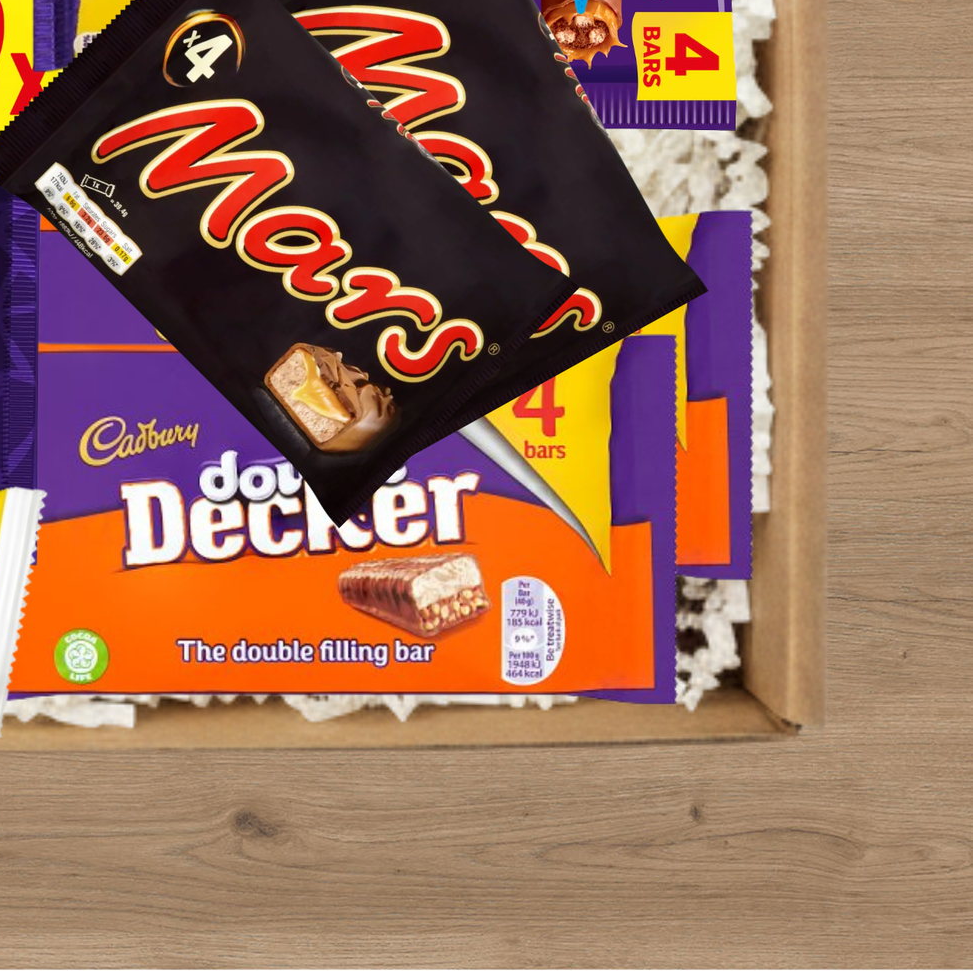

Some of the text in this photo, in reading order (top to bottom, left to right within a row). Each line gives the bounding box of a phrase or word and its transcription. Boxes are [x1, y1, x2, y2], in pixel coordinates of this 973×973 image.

[183, 30, 233, 83] x4
[643, 27, 661, 87] BARS
[665, 33, 719, 77] 4
[92, 181, 100, 189] 1x
[72, 191, 81, 200] Fat
[83, 203, 101, 223] Saturates
[113, 201, 129, 217] 39.4g
[101, 221, 117, 239] Sugars
[92, 99, 484, 382] Mars
[122, 243, 133, 254] Salt
[512, 376, 565, 437] 4
[80, 415, 199, 467] Cadbury
[524, 440, 566, 459] bars
[511, 609, 527, 617] 779
[524, 618, 543, 626] kcal
[546, 598, 555, 661] Be treatwise
[177, 639, 436, 669] The double filling bar
[506, 669, 543, 677] 464 kcal
[507, 661, 530, 669] 1948
